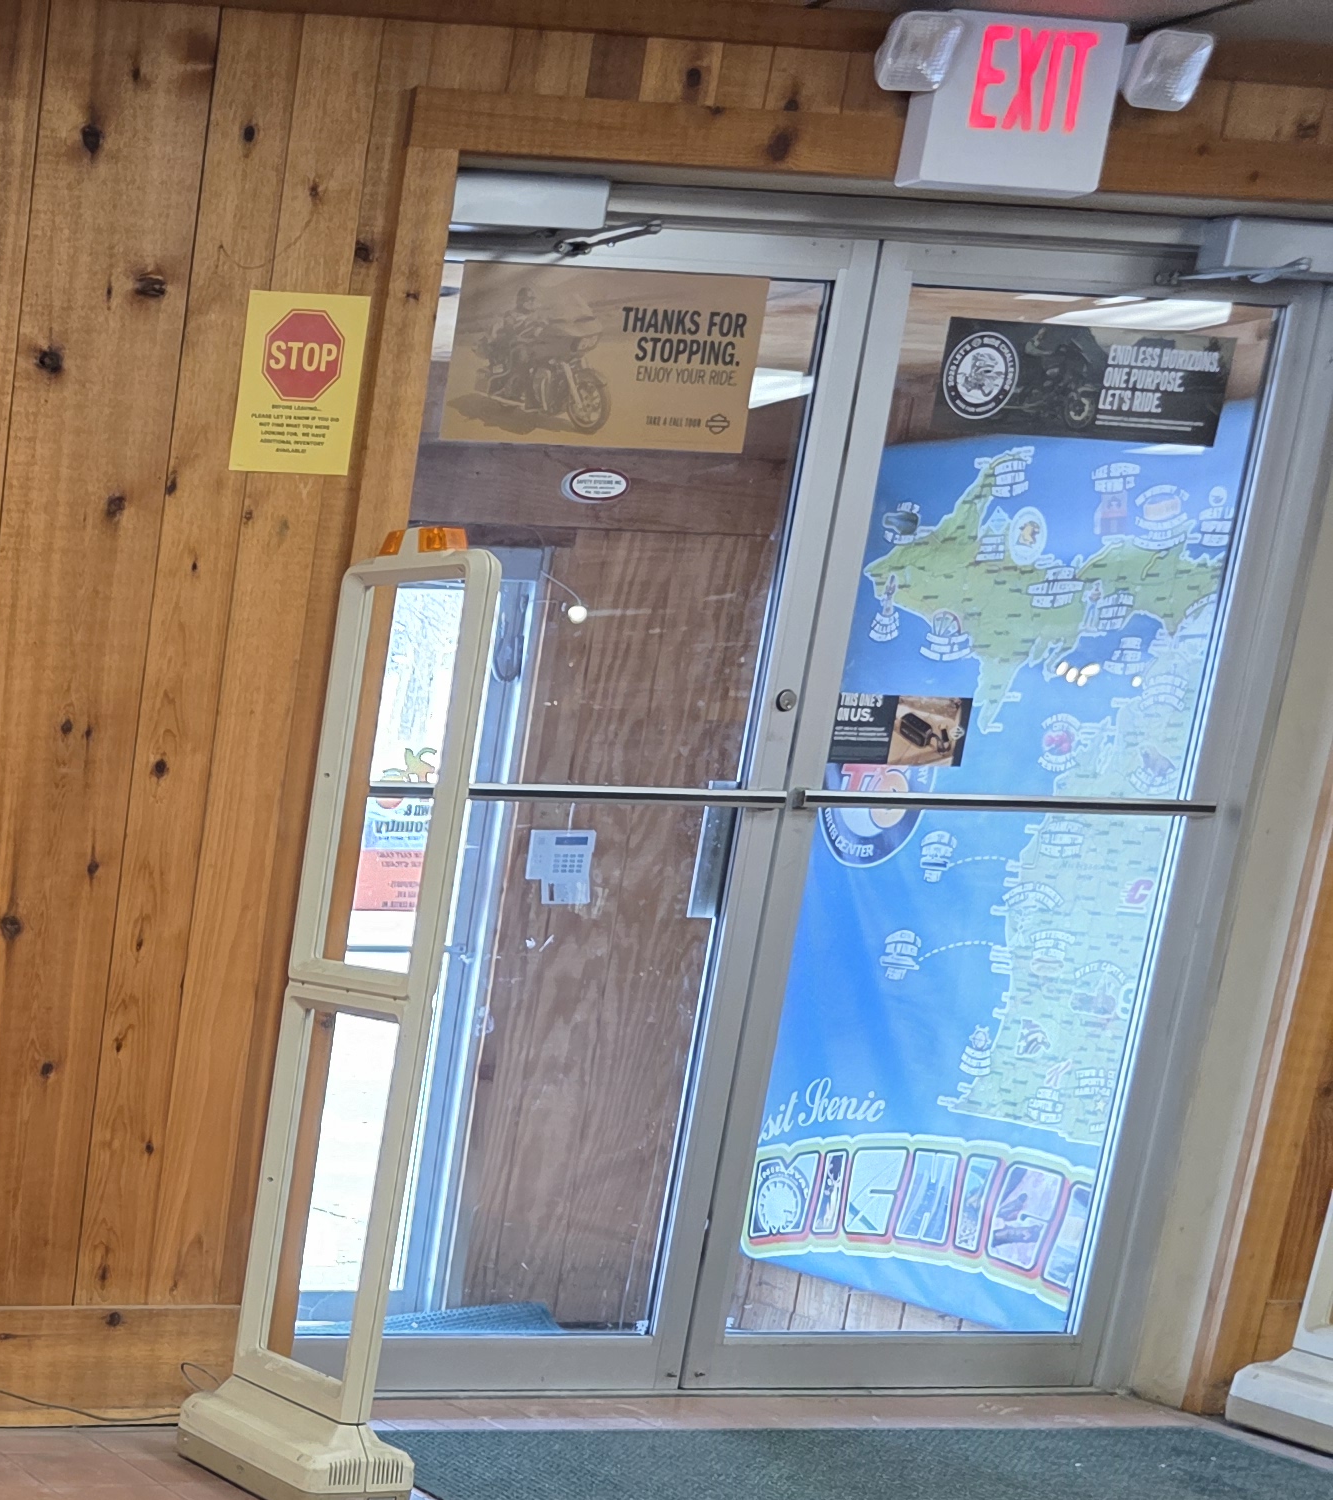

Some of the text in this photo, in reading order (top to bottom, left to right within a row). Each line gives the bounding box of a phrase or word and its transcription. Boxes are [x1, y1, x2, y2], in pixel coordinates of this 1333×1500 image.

[967, 24, 1099, 133] EXIT
[622, 306, 747, 338] THANKS FOR
[269, 341, 337, 372] STOP
[635, 337, 740, 366] STOPPING.
[1107, 344, 1220, 372] ENDLESS HORIZONS.
[636, 365, 673, 383] ENJOY
[675, 367, 706, 385] YOUR
[1103, 367, 1130, 388] ONE
[1098, 389, 1132, 411] LET'S
[840, 692, 883, 707] THIS ONE'S
[837, 707, 874, 722] ON US.
[825, 807, 874, 857] ORTS CENTER
[758, 1077, 886, 1145] sit Scenic
